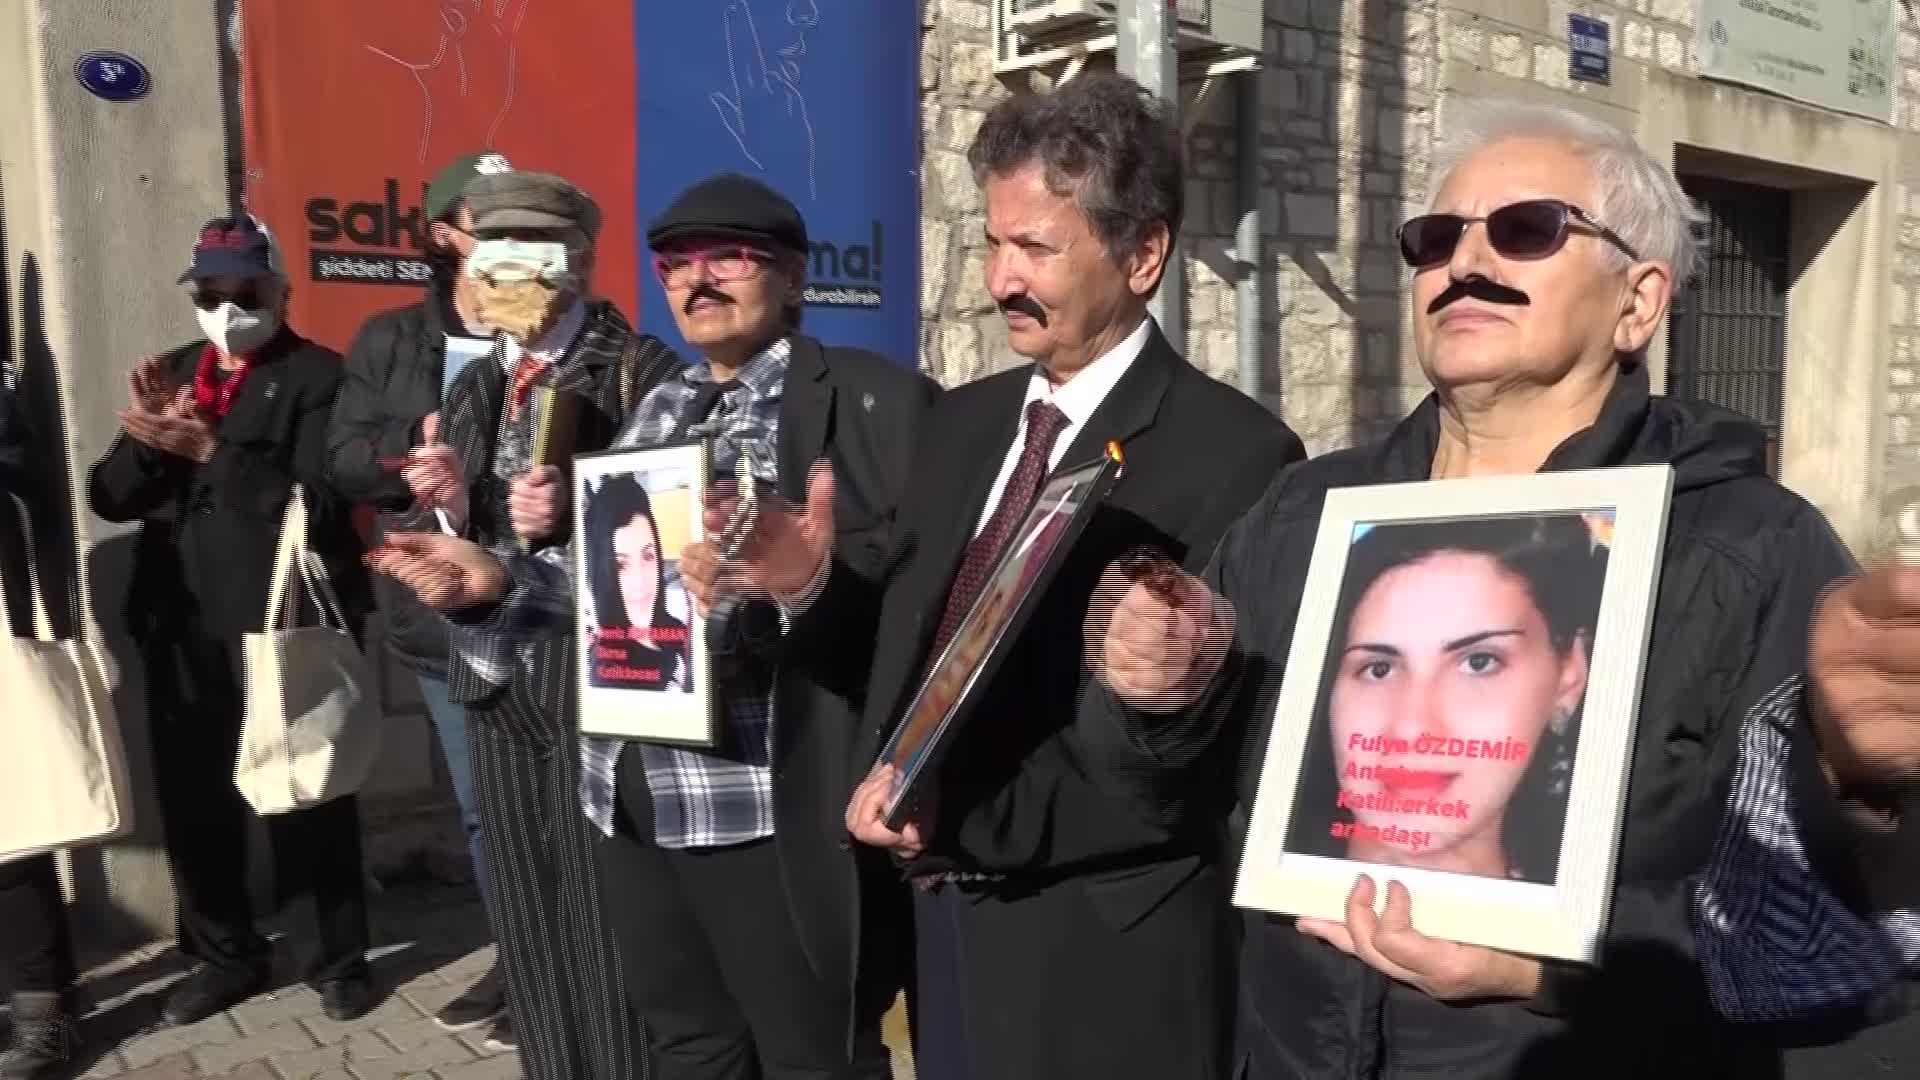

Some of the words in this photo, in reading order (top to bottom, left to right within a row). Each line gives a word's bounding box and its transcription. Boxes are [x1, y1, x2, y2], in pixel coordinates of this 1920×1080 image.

[306, 178, 431, 248] sak
[806, 219, 884, 282] ma!
[319, 257, 393, 281] şiddeti
[804, 287, 881, 305] durabilirsin
[1347, 733, 1409, 757] Fulya
[1415, 732, 1530, 761] ÖZDEMİR
[1330, 820, 1431, 850] aradaşı
